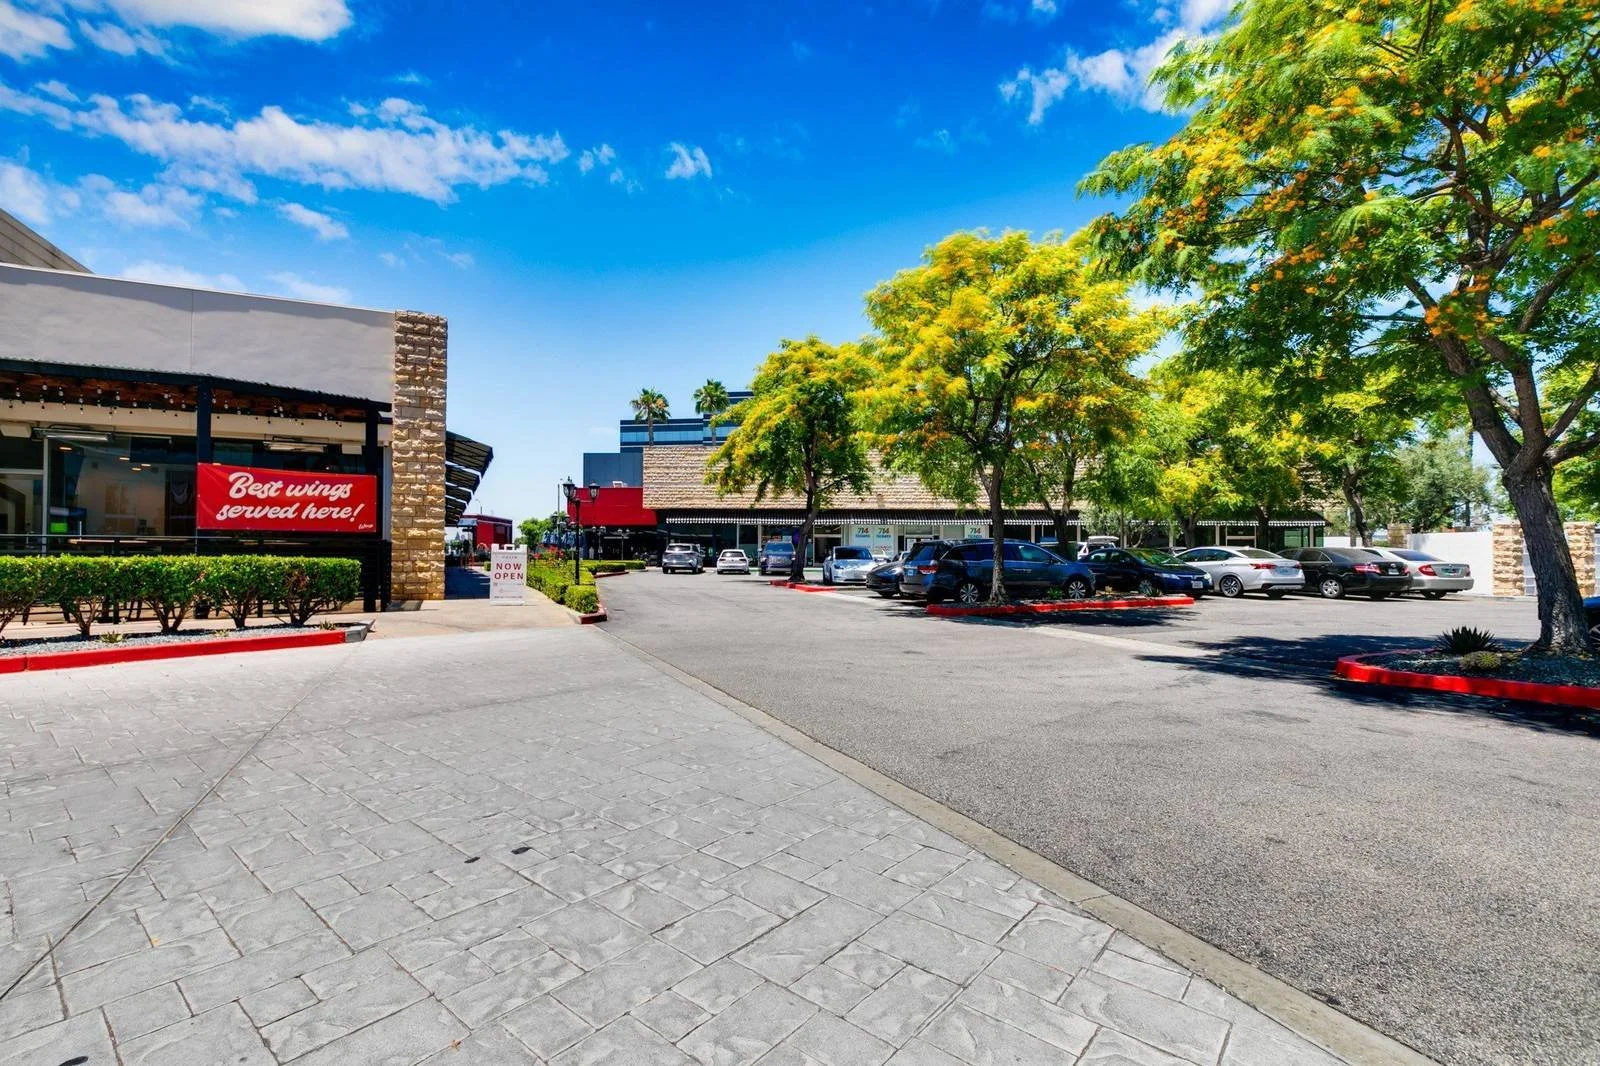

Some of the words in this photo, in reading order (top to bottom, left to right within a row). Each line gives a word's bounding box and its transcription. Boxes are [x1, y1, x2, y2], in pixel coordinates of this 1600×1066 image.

[228, 472, 284, 499] Best
[286, 480, 353, 502] wings
[215, 502, 300, 521] served
[301, 502, 365, 522] here!
[494, 572, 524, 580] OPEN
